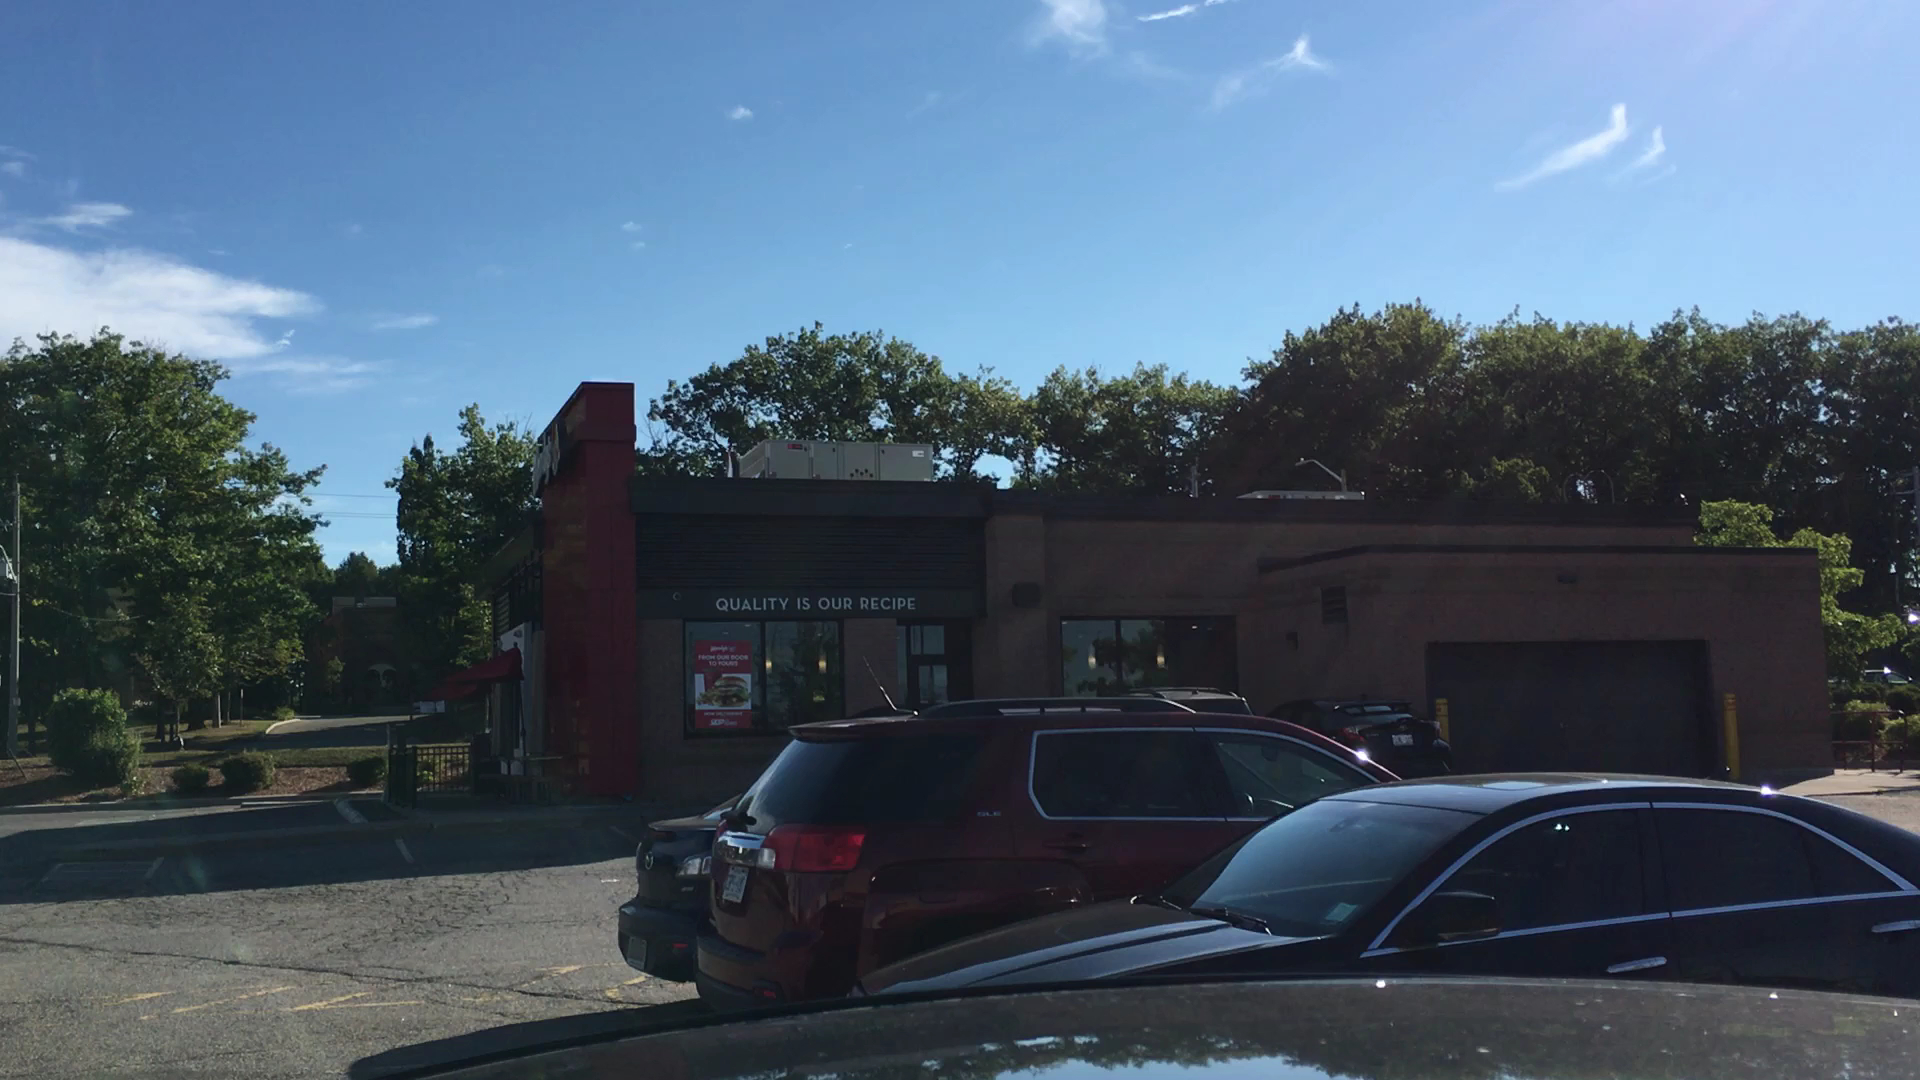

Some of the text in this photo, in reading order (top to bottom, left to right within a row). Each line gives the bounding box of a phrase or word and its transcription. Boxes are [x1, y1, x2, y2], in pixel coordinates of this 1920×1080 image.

[715, 597, 916, 612] QUALITY IS OUR RECIPE
